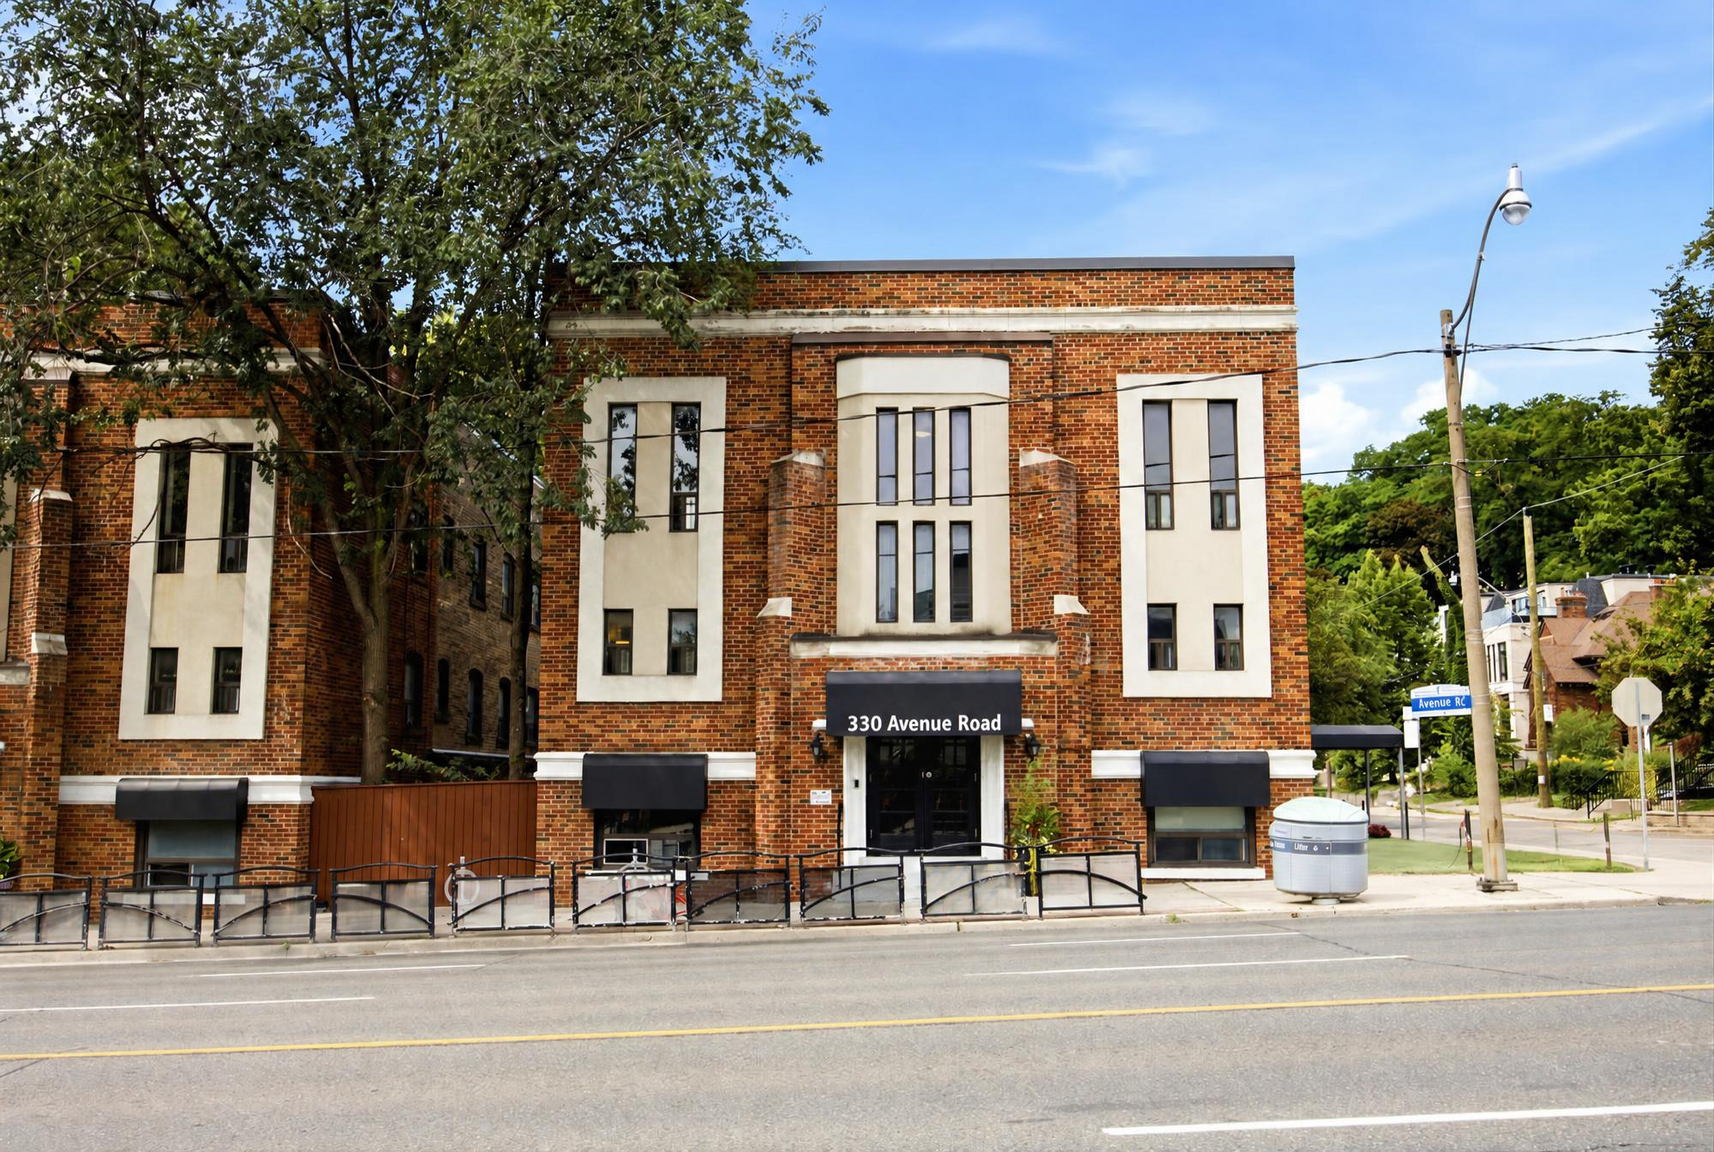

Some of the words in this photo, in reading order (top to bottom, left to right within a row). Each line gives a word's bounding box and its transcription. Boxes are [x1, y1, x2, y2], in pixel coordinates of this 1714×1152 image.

[1418, 698, 1452, 709] Avenue
[848, 715, 882, 732] 330
[887, 715, 952, 731] Avenue
[958, 714, 1001, 731] Road
